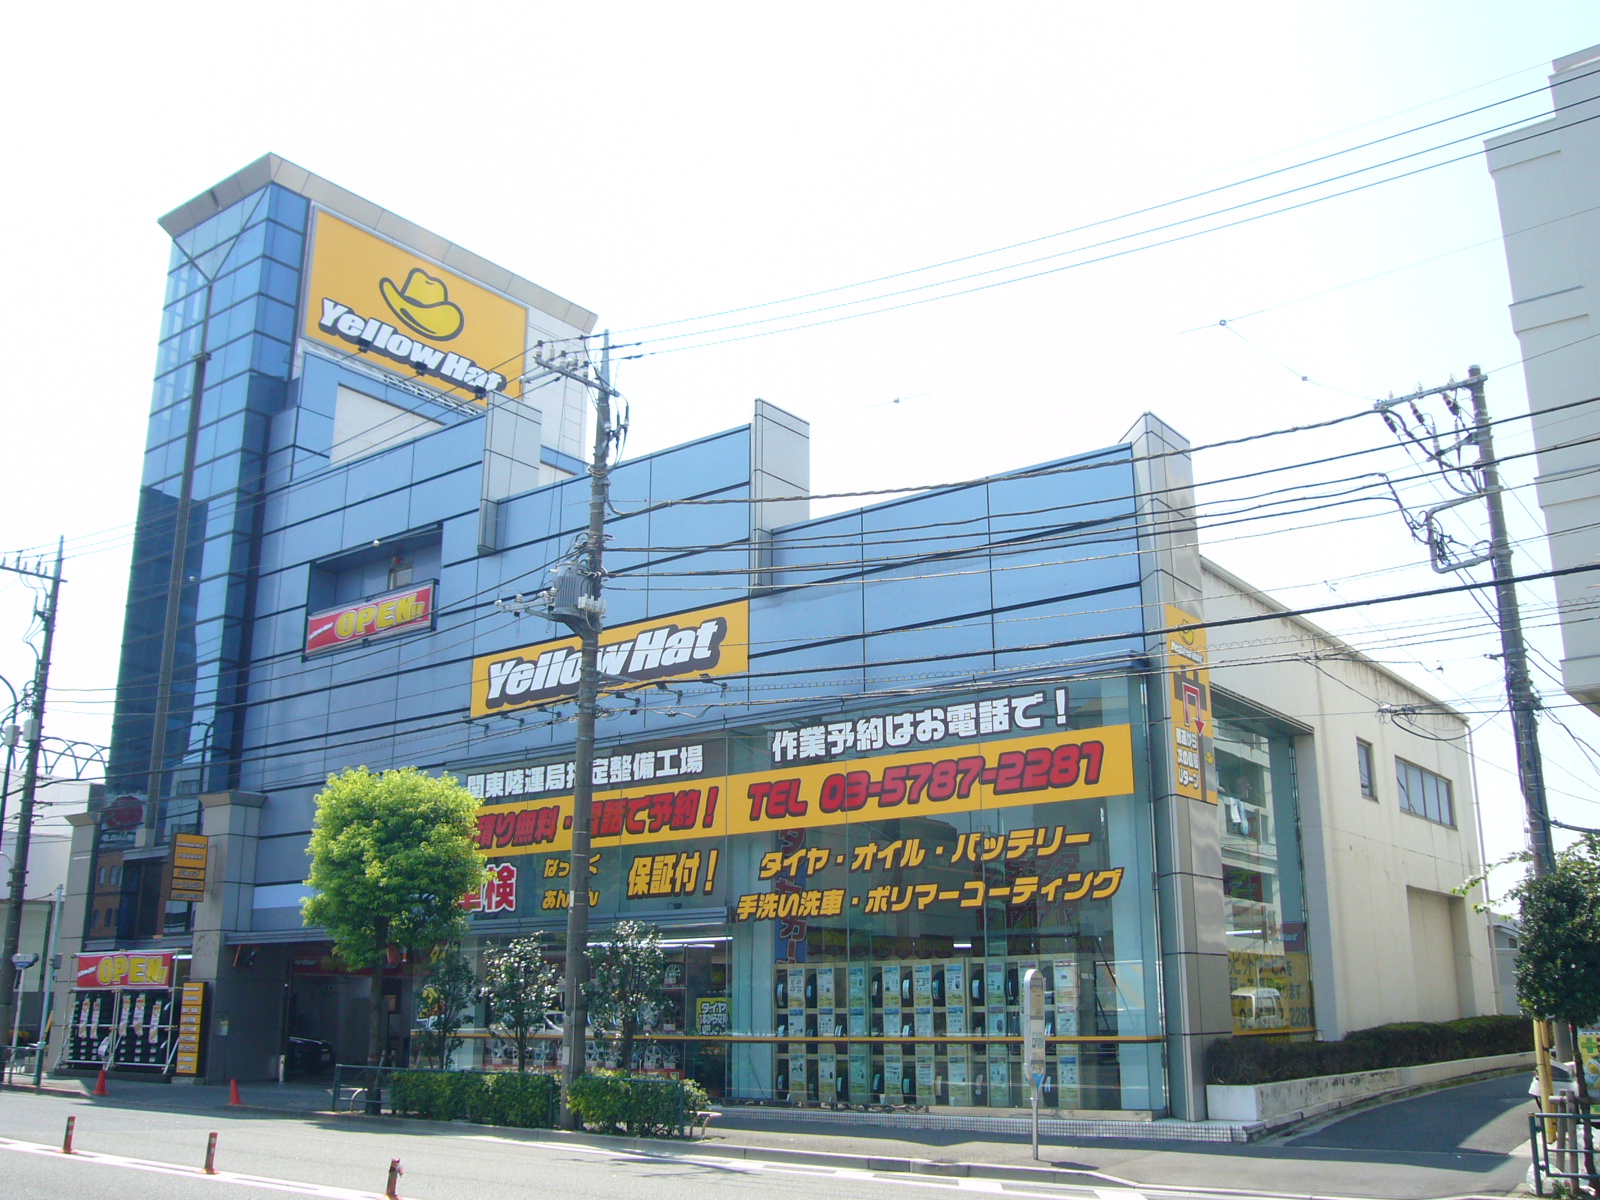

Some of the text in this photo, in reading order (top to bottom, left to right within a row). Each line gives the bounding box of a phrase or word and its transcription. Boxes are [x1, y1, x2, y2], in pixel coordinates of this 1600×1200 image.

[747, 740, 1104, 821] TEL 03-5787-2281
[543, 853, 602, 879] なっく
[736, 868, 1125, 923] 手洗い洗車・ポリマーコーティング
